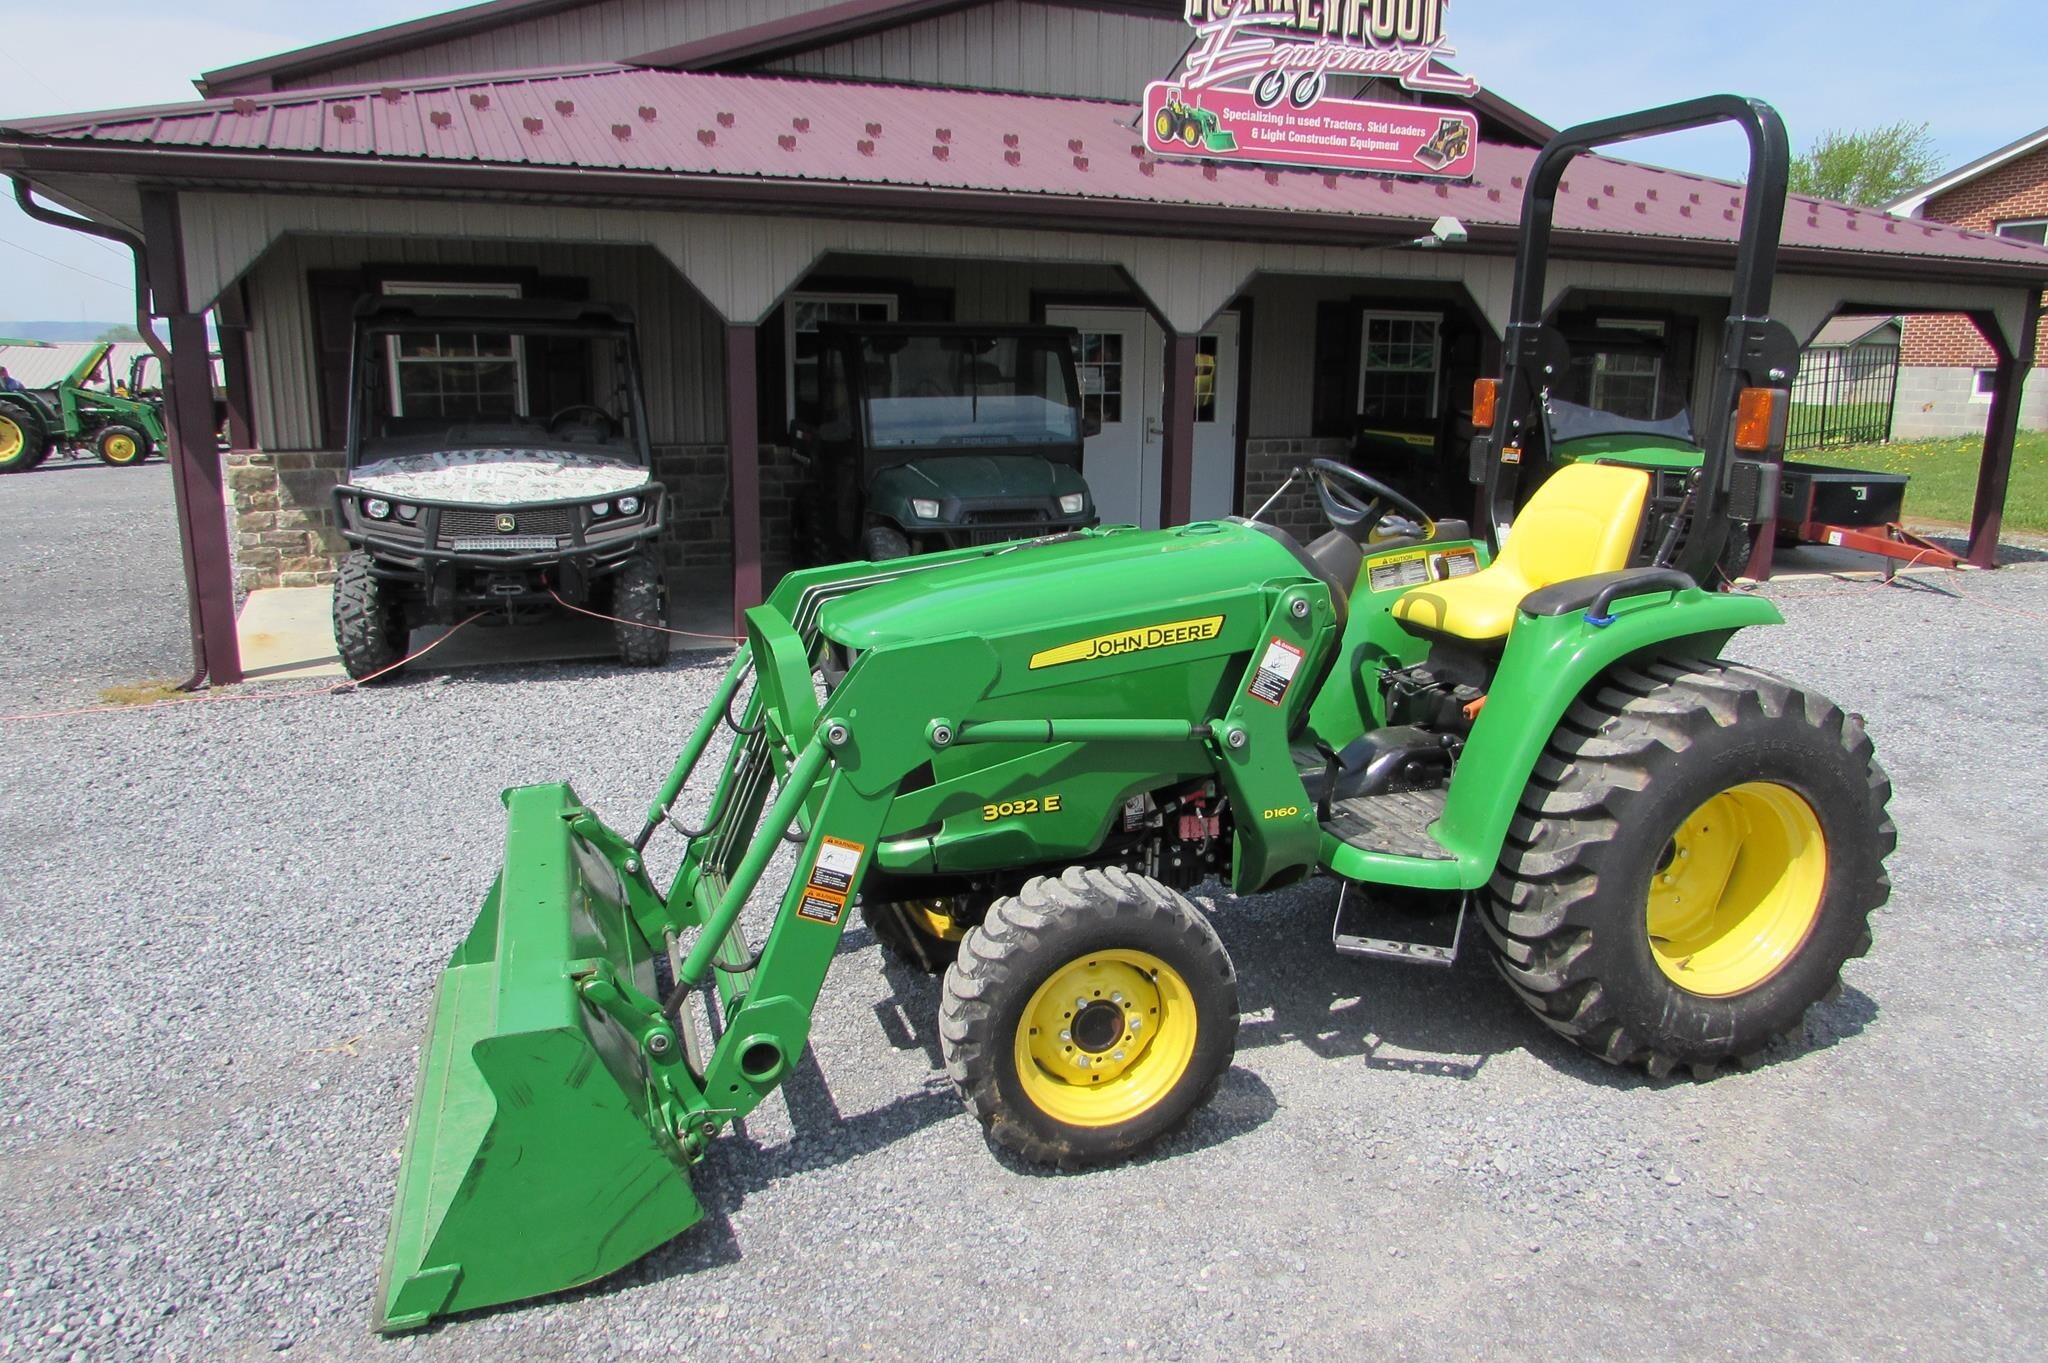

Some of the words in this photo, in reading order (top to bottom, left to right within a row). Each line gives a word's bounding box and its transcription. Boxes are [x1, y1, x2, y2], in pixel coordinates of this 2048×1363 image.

[1187, 0, 1447, 46] EYFOOT
[1188, 8, 1474, 92] Equipment
[1222, 107, 1284, 126] Specializing
[1285, 113, 1296, 125] in
[1297, 117, 1321, 127] used
[1367, 121, 1388, 134] Skid
[1390, 123, 1426, 137] Loaders
[1251, 127, 1259, 139] &
[1261, 129, 1286, 143] Light
[1288, 131, 1348, 147] Construction
[1349, 136, 1399, 151] Equipment
[1086, 634, 1142, 657] JOHN
[1147, 623, 1213, 644] DEERE
[983, 799, 1039, 821] 3032
[1044, 795, 1060, 812] E
[1264, 806, 1298, 819] D160
